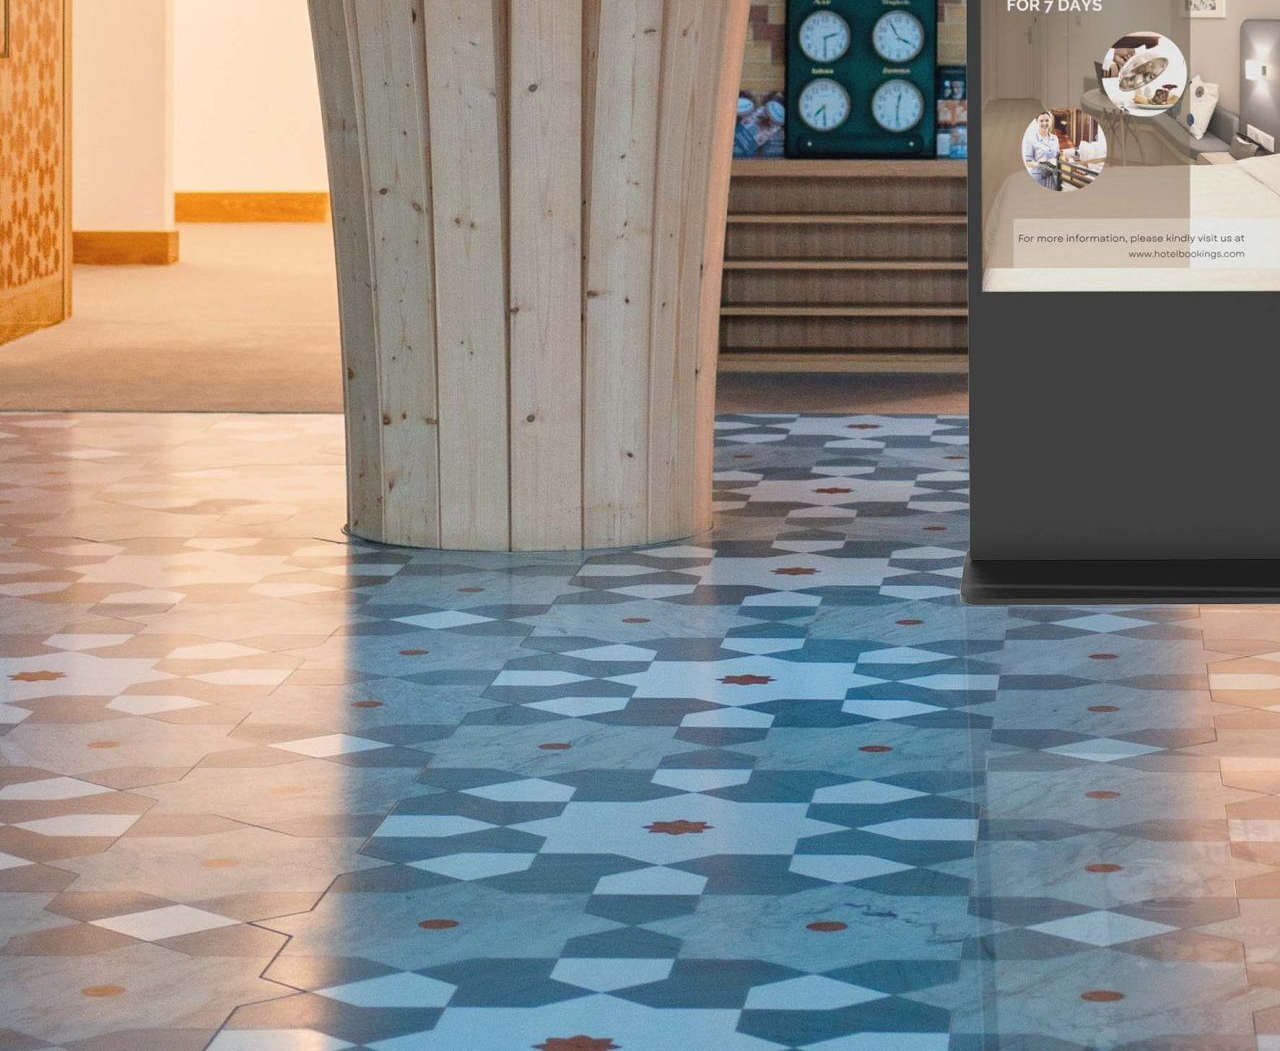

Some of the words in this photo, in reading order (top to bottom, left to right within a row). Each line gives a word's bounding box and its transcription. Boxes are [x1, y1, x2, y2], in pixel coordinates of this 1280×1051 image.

[1007, 0, 1040, 12] FOR
[1044, 1, 1053, 14] 7
[1058, 0, 1103, 12] DAYS
[1018, 234, 1034, 243] For
[1037, 235, 1064, 243] more
[1066, 233, 1128, 244] information,
[1130, 234, 1163, 243] please
[1166, 234, 1195, 244] kindly
[1197, 234, 1218, 243] visit
[1220, 235, 1232, 243] us
[1234, 235, 1245, 243] at
[1128, 250, 1246, 260] www.hotelbookings.com
